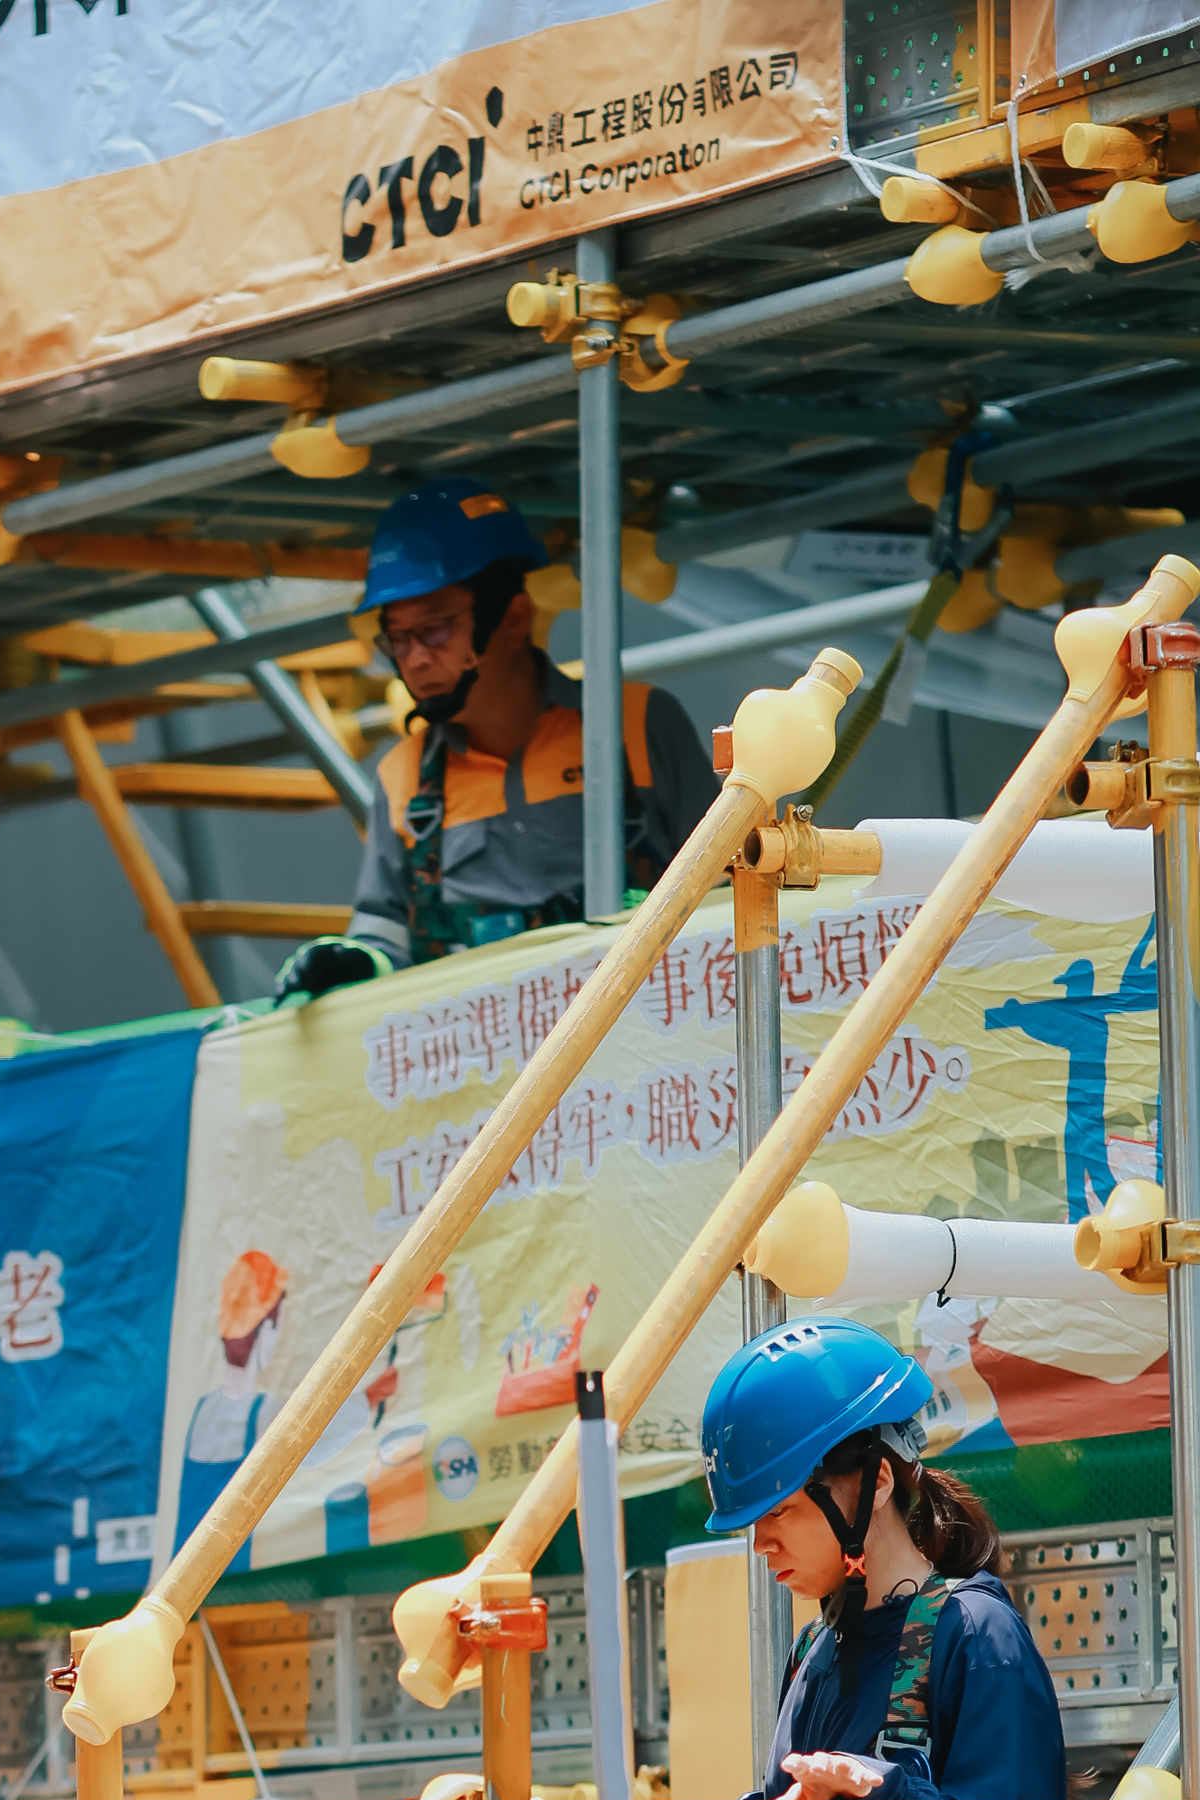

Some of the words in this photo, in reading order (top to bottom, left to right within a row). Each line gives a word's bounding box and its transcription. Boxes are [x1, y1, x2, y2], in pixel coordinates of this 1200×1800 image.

[526, 51, 799, 160] 中鼎工程股份有限公司
[340, 136, 486, 263] CTCI
[519, 168, 570, 210] CTCI
[580, 137, 721, 194] Corporation
